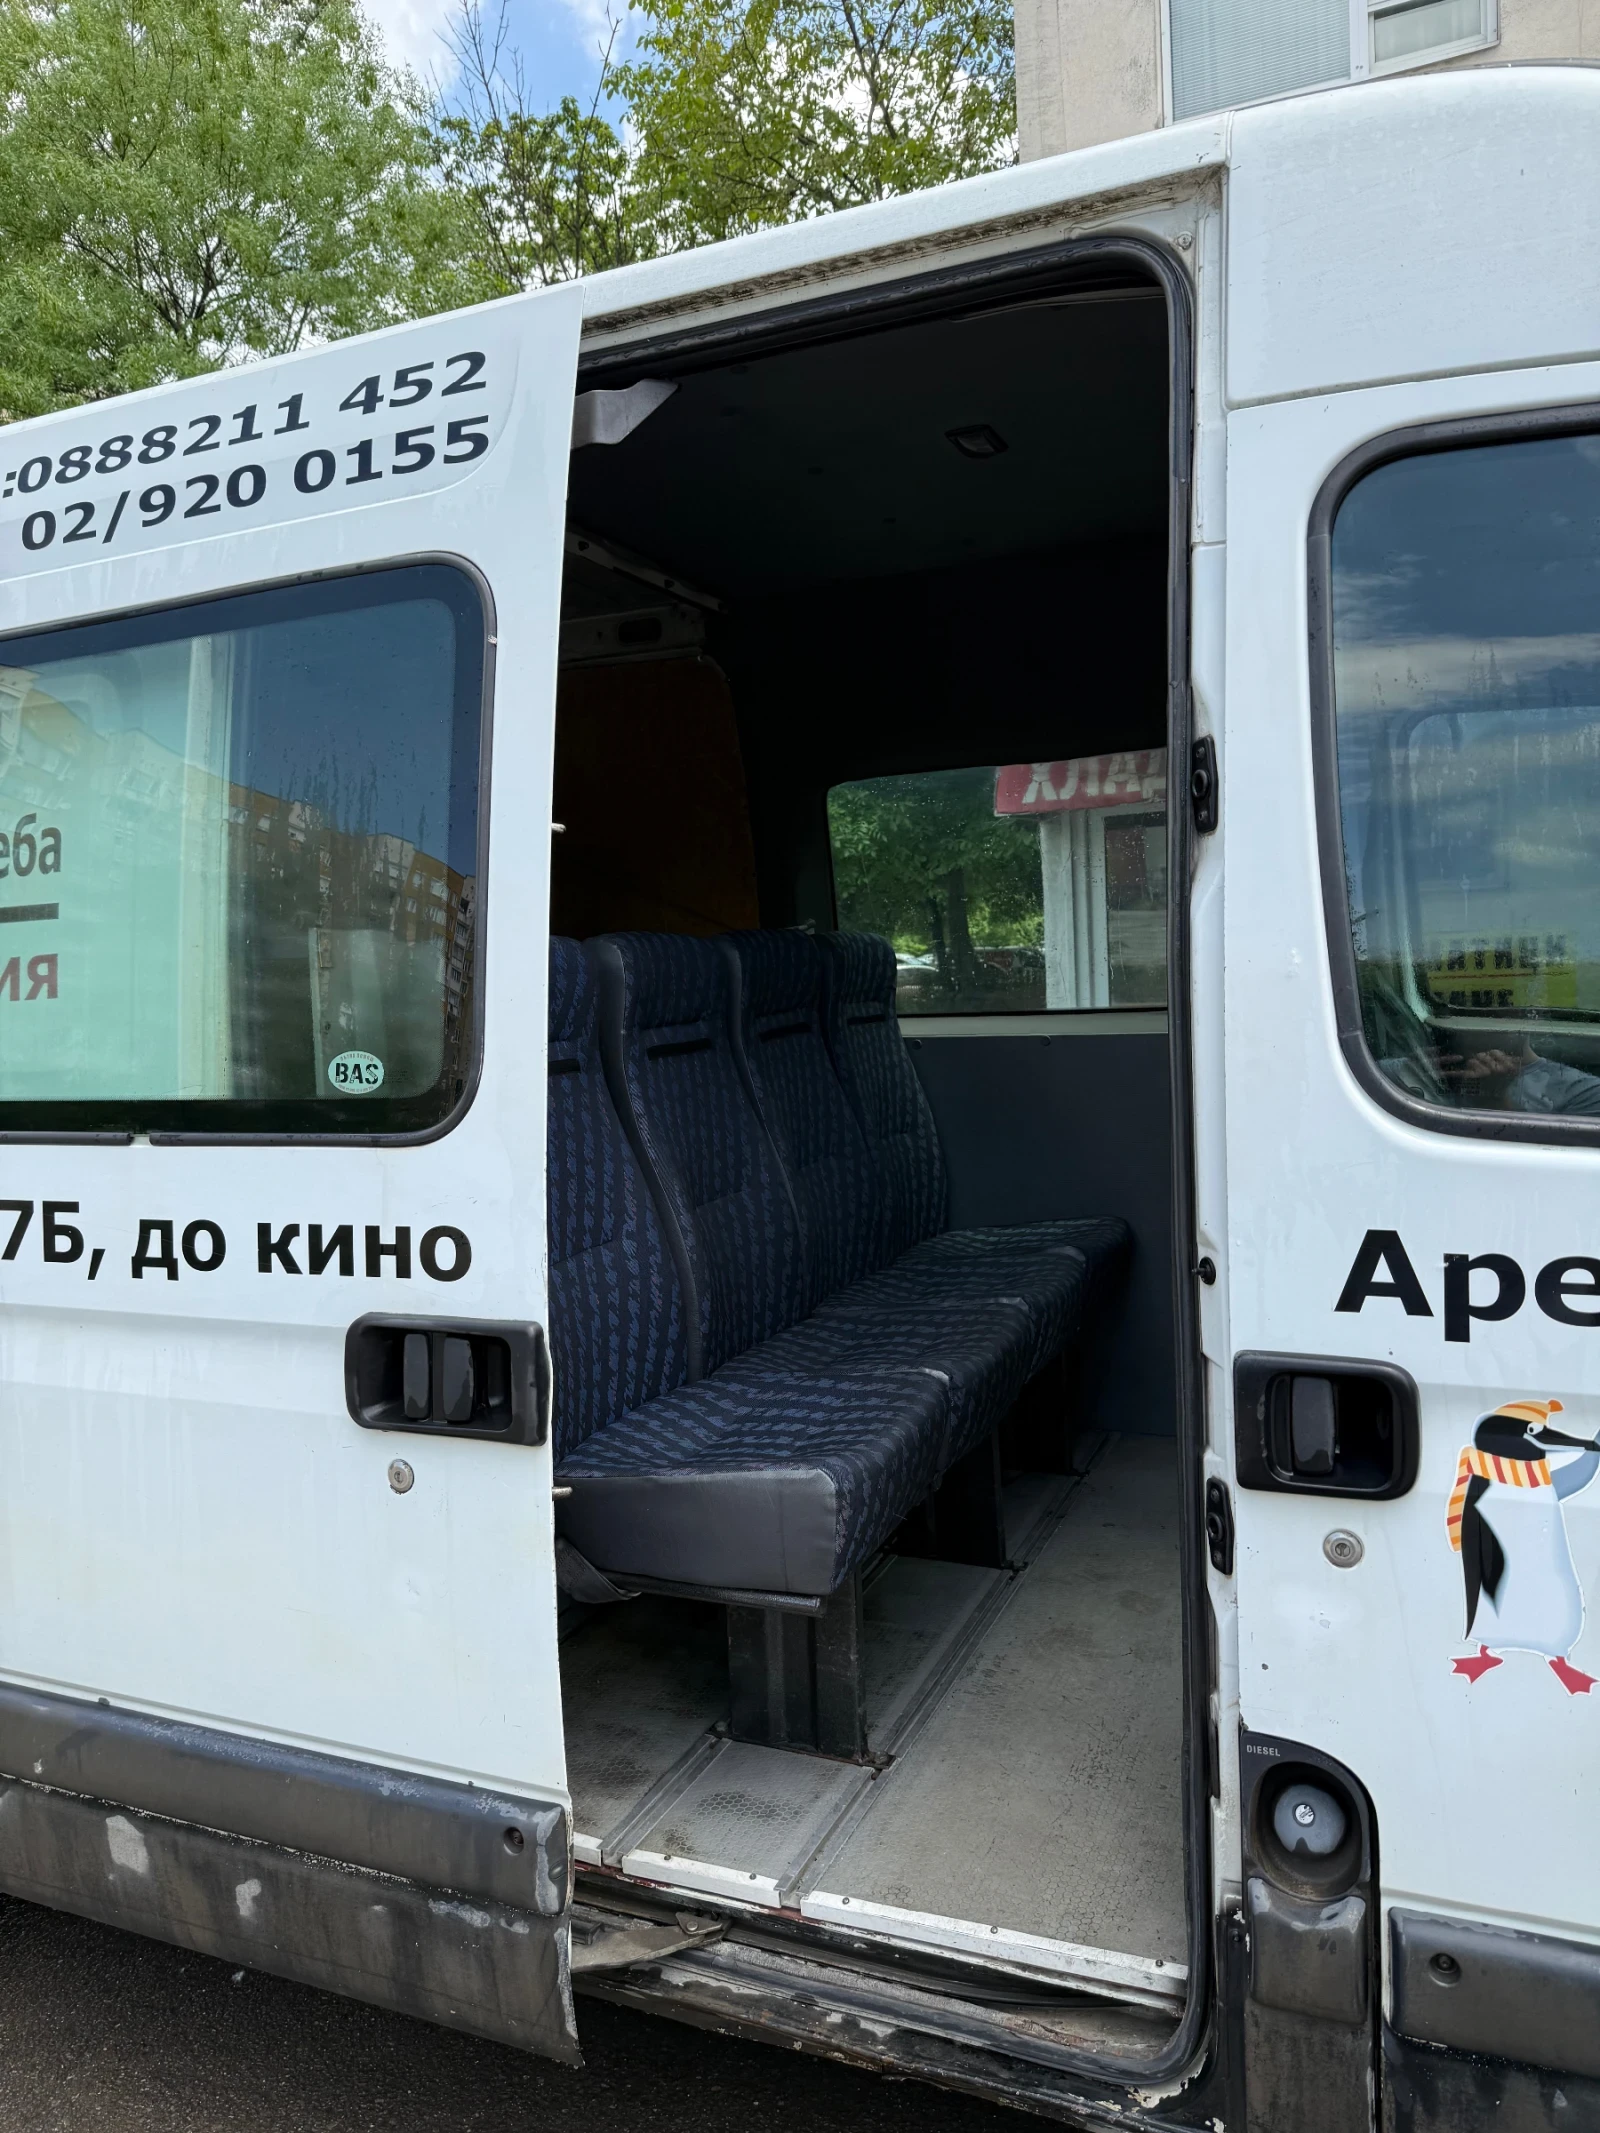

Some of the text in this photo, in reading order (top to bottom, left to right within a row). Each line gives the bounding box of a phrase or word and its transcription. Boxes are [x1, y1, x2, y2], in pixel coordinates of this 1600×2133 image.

[2, 351, 487, 498] :0888211 452
[21, 415, 489, 551] 02/920 0155
[335, 1062, 379, 1085] BAS
[131, 1219, 226, 1281] до
[257, 1222, 472, 1282] кино
[1246, 1744, 1281, 1757] DIESEL
